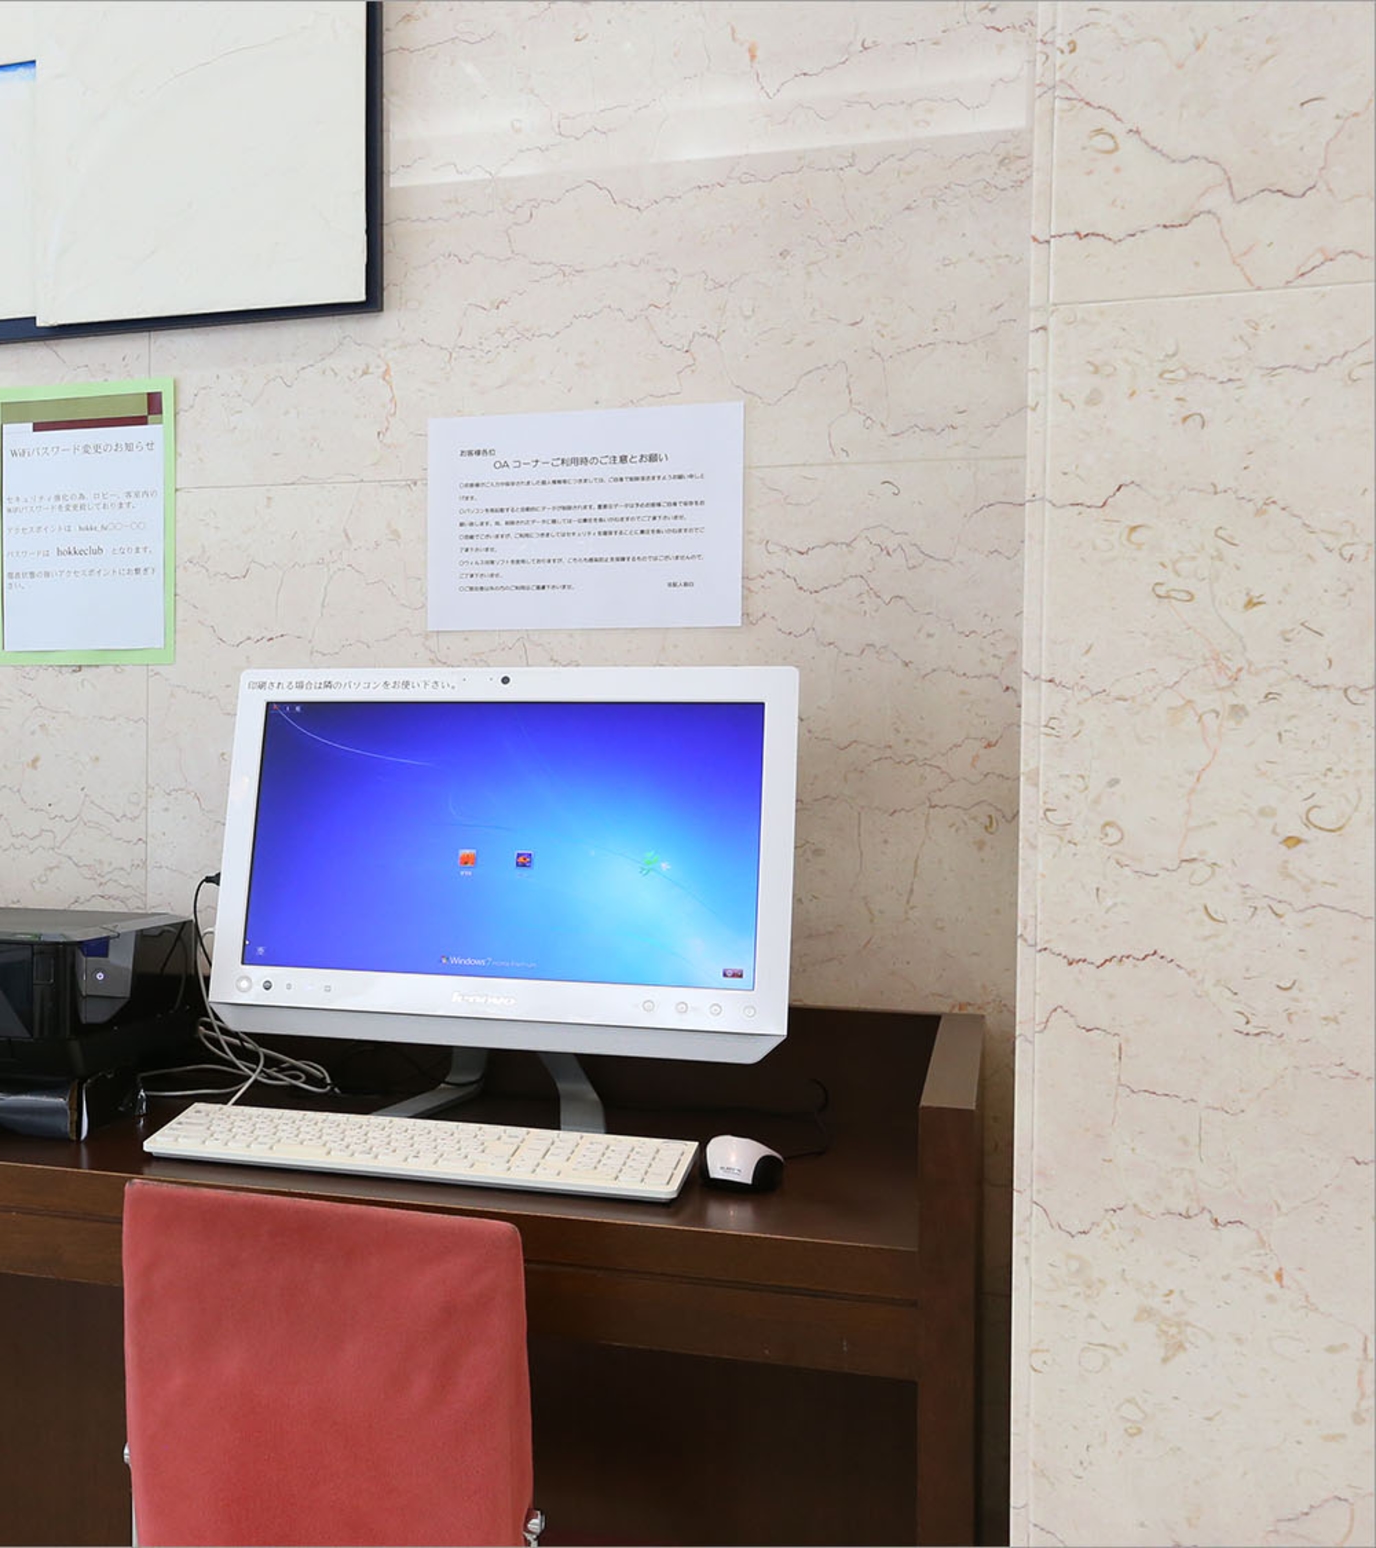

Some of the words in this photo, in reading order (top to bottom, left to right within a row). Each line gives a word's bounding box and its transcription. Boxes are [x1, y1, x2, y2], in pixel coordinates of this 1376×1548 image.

[10, 441, 155, 457] WiFiパスワード変更のお知らせ
[493, 460, 510, 470] OA
[512, 453, 669, 469] コーナーご利用時のご注意とお願い
[56, 545, 104, 557] hokkeclub
[247, 679, 457, 691] 印刷される場合は隣のパソコンをお使い下さい。
[449, 956, 485, 966] Windows
